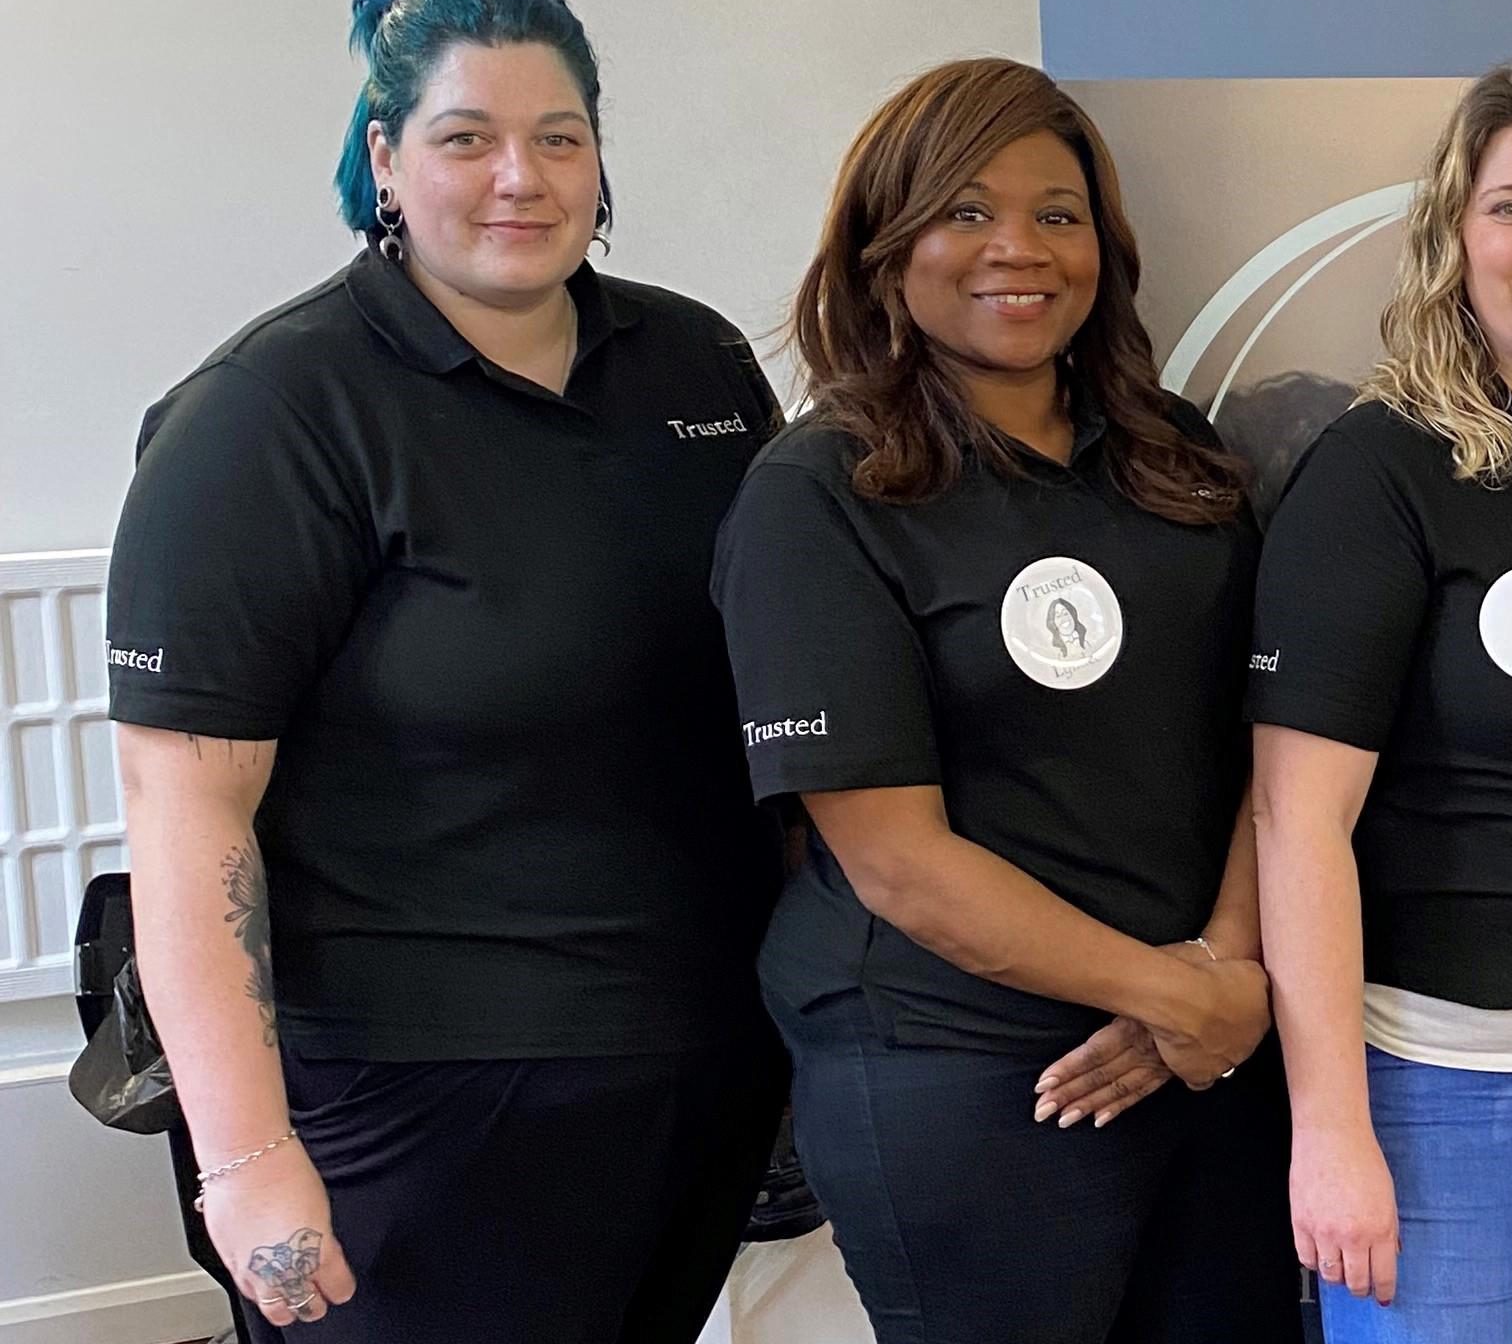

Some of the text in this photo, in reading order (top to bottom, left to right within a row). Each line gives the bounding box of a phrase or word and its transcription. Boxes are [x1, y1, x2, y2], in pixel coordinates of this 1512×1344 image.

[667, 412, 747, 439] Trusted
[1016, 565, 1083, 602] Trusted
[743, 710, 828, 746] Trusted
